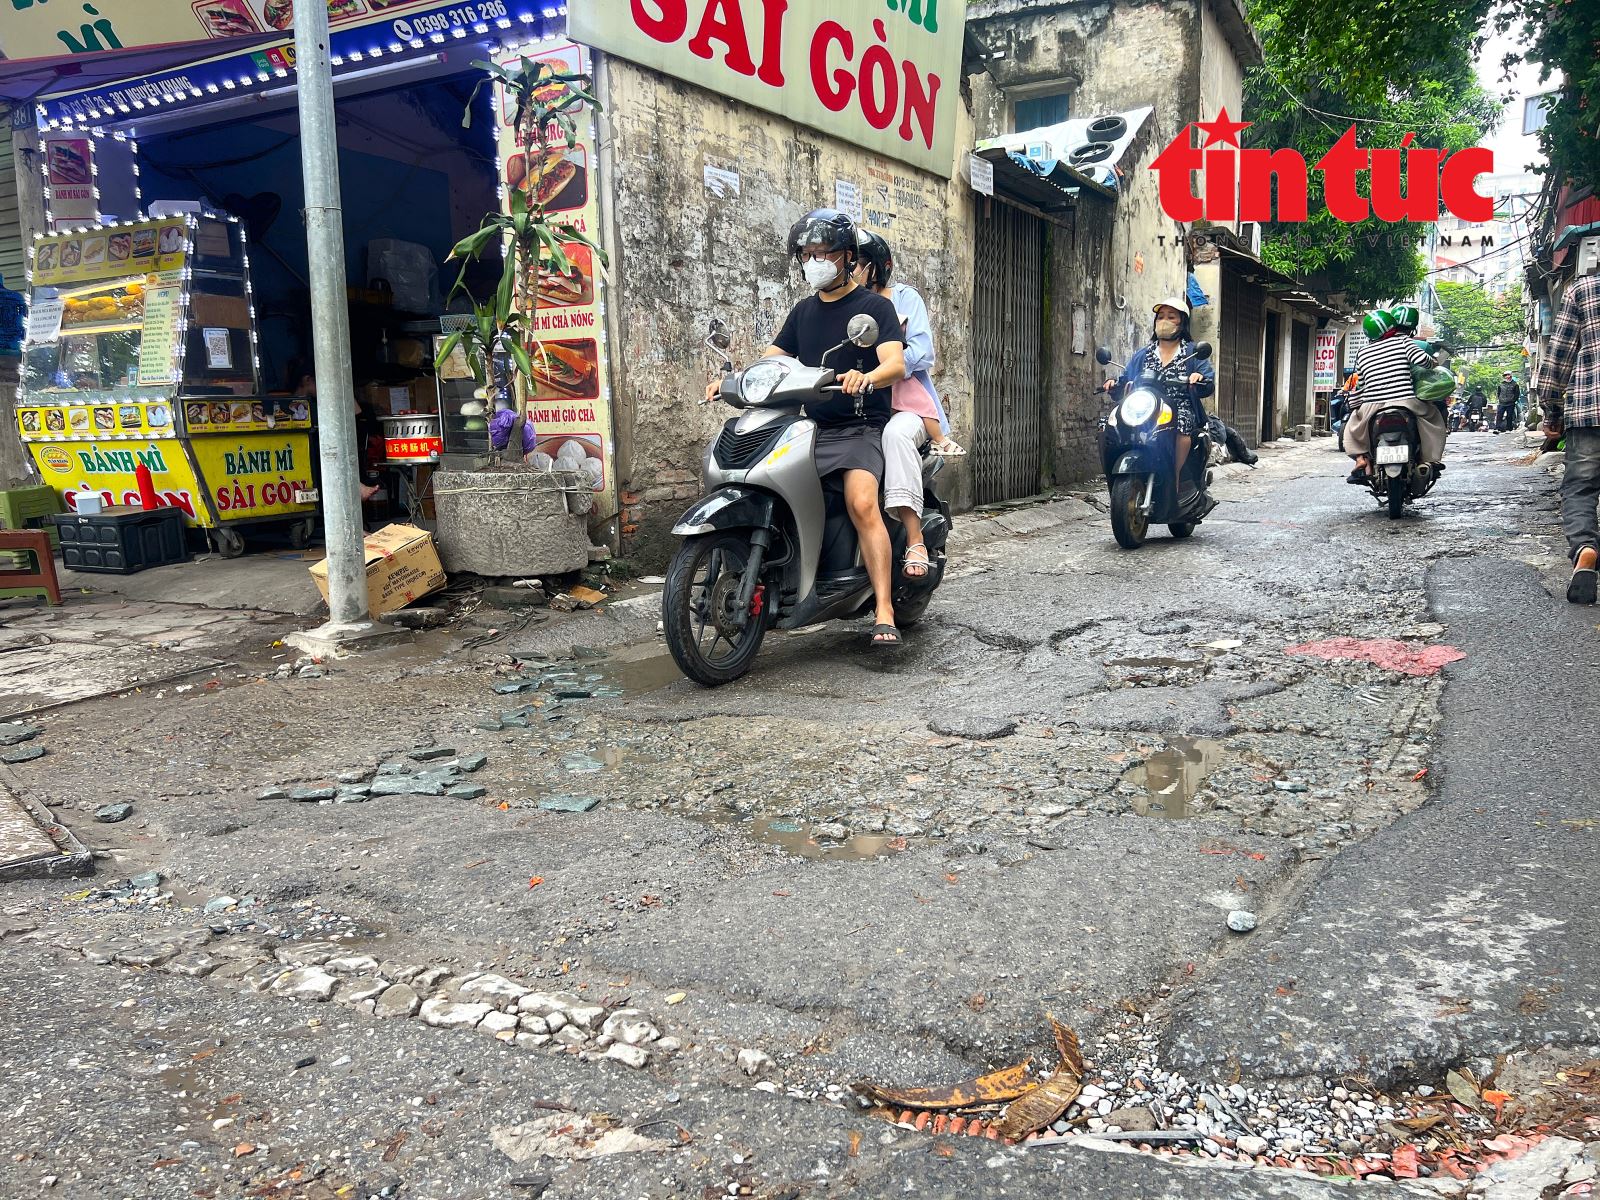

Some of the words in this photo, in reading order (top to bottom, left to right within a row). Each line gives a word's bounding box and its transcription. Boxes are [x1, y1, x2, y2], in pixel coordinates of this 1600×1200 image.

[413, 13, 450, 35] 0398
[449, 6, 478, 27] 316
[477, 0, 508, 20] 286
[108, 90, 128, 104] 381
[158, 75, 193, 96] KHANG
[809, 18, 941, 150] GÒN
[574, 213, 586, 232] CÁ
[541, 312, 551, 329] MÌ
[1317, 336, 1336, 347] TIVI
[1315, 349, 1335, 360] LCD
[551, 405, 561, 422] MÌ
[136, 444, 168, 472] MÌ
[275, 443, 295, 471] MÌ
[217, 479, 257, 511] SÀI
[406, 539, 430, 554] kewpie
